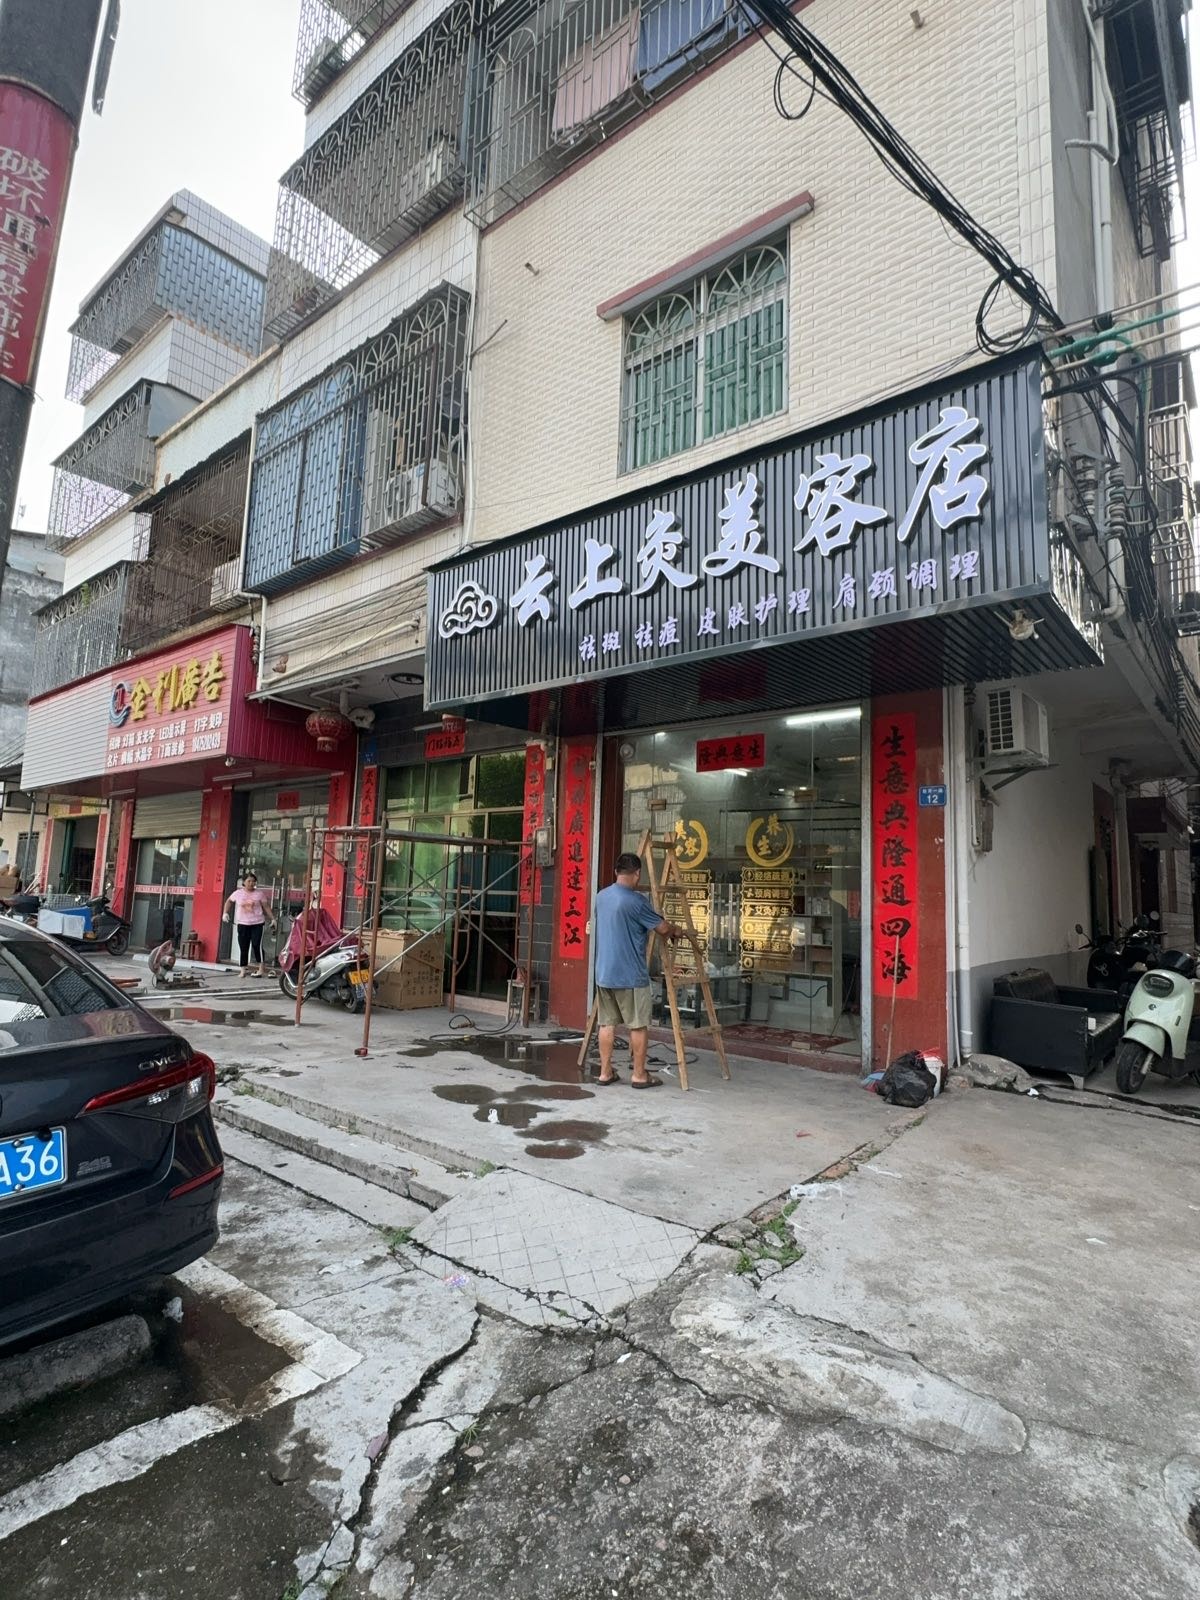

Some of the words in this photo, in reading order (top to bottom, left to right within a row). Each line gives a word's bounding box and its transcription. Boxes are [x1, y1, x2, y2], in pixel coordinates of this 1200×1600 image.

[509, 406, 989, 627] 云上灸美容店
[577, 630, 622, 661] 祛斑
[634, 616, 681, 650] 祛痘
[696, 587, 813, 637] 皮肤护理
[832, 549, 981, 611] 肩颈调理
[926, 793, 939, 804] 12
[754, 904, 790, 916] 艾灸养生
[138, 1054, 177, 1071] CIVIC
